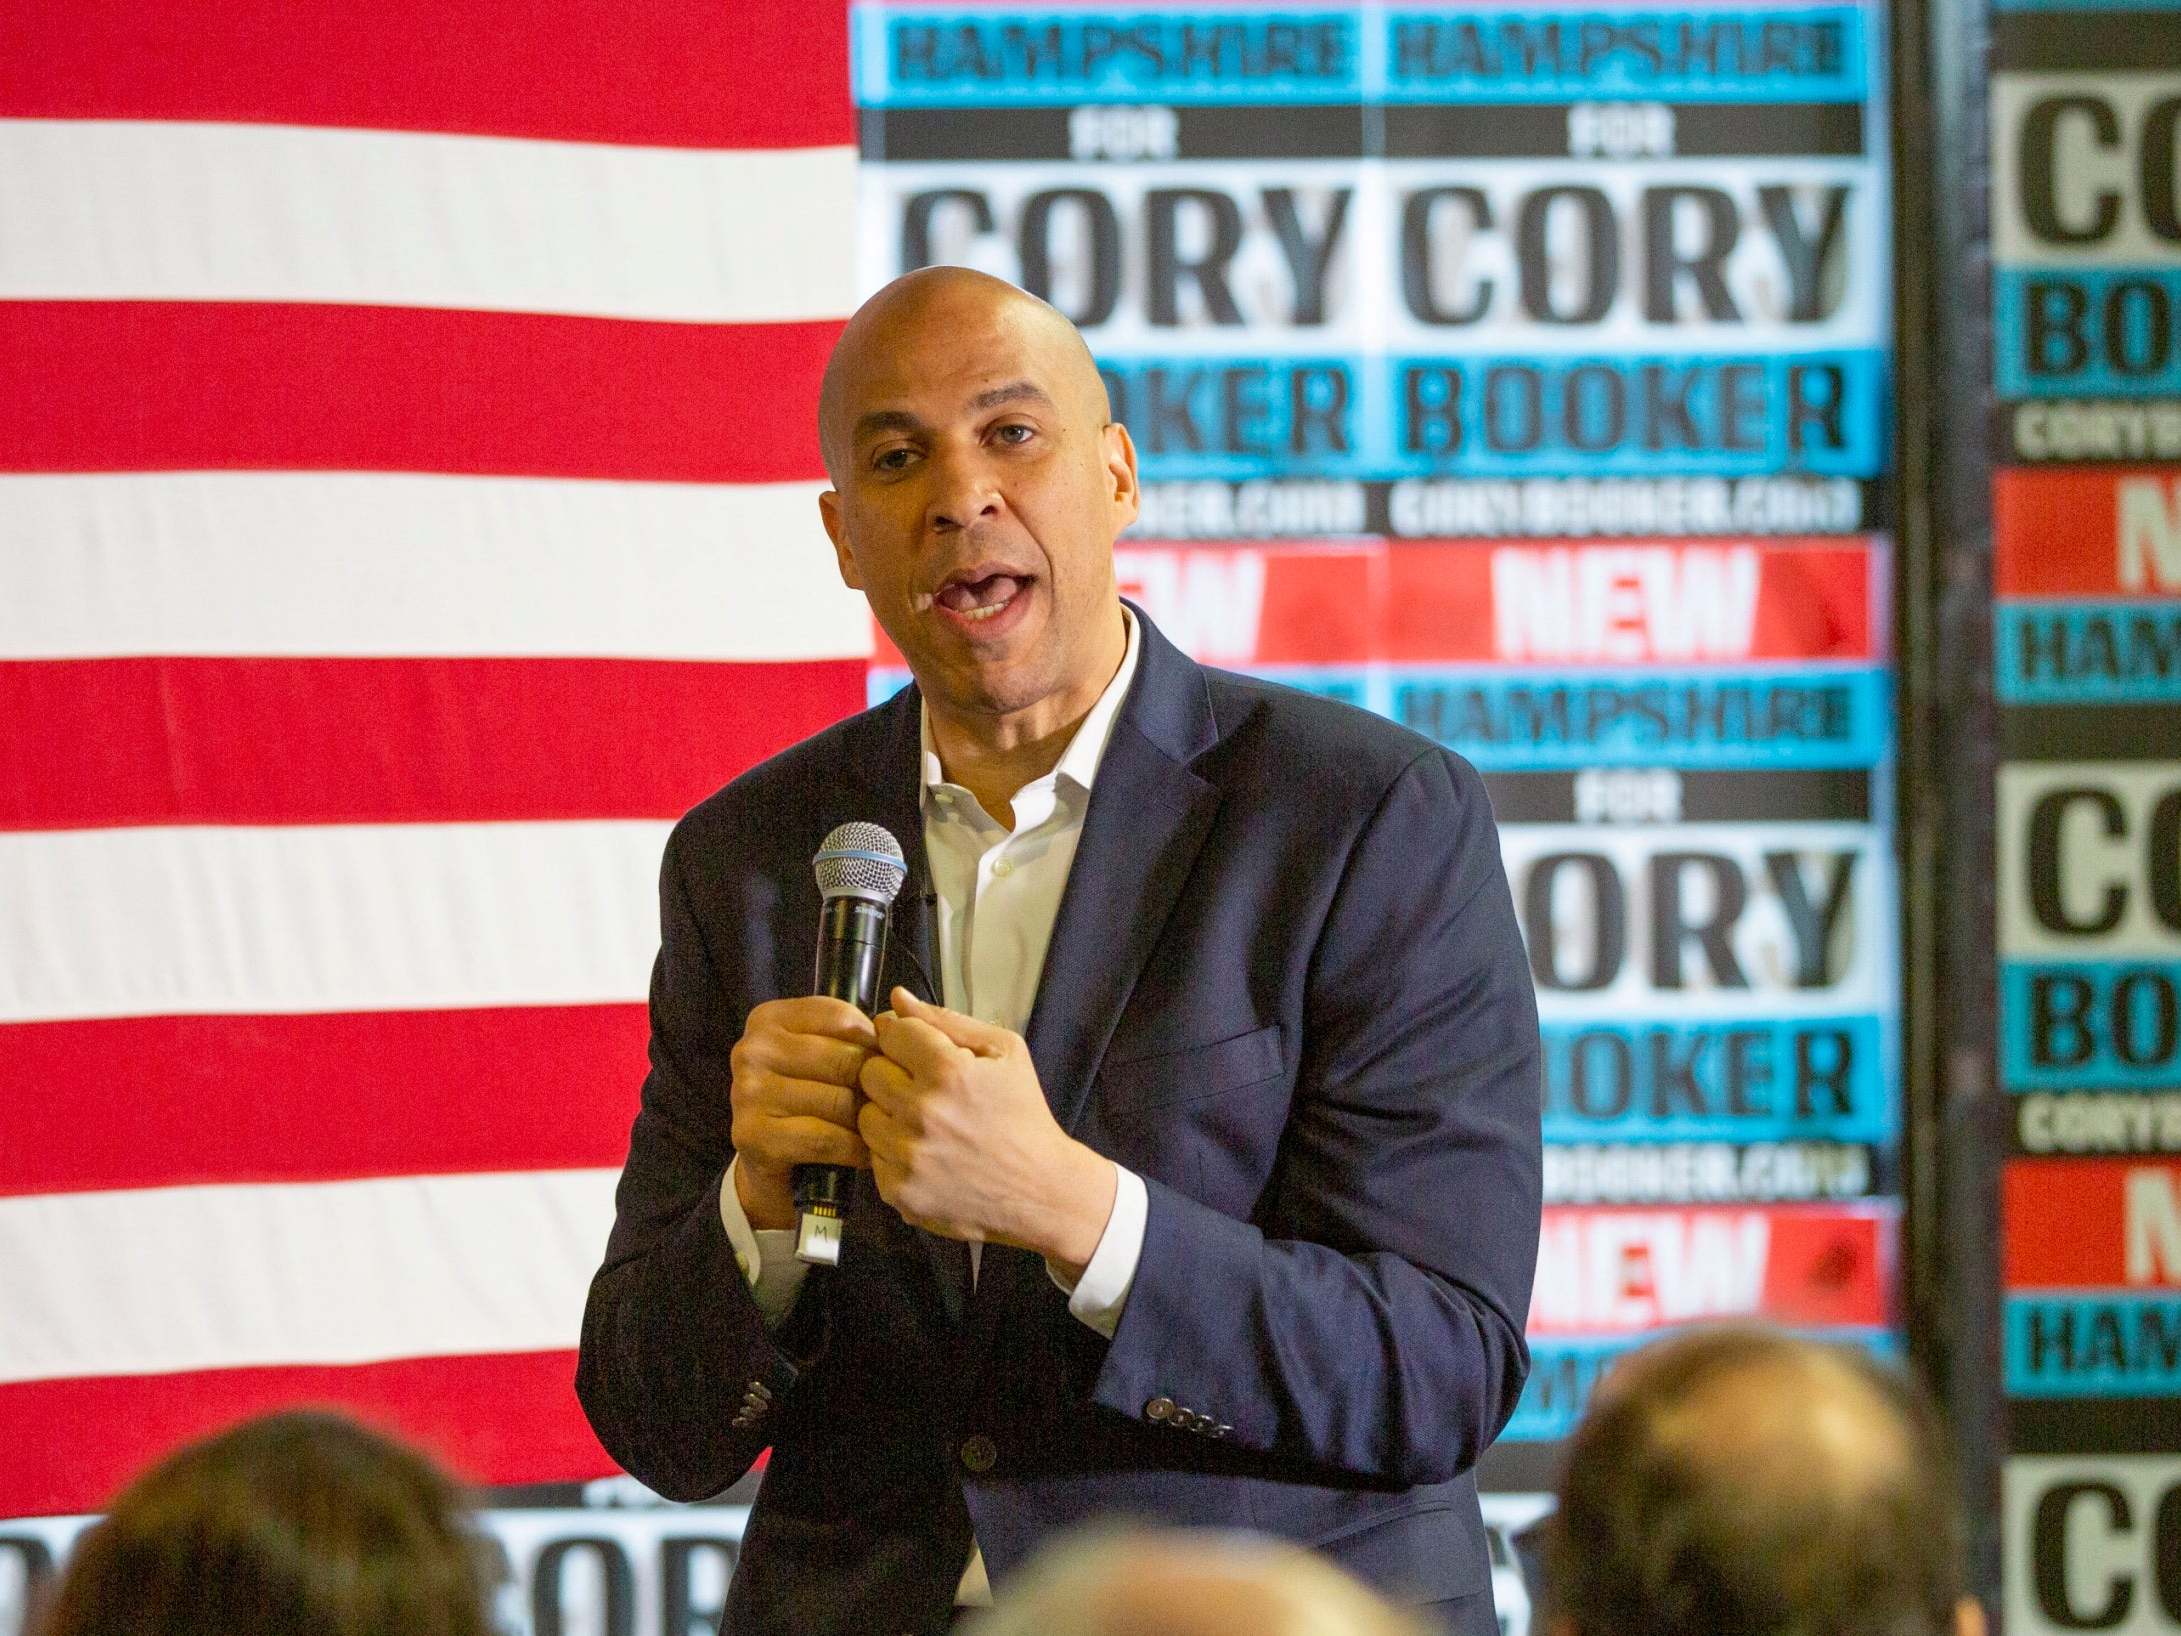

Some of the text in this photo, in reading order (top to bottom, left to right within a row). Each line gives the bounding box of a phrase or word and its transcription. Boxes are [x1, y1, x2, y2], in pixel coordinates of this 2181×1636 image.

[898, 21, 1345, 80] HAMPSHIRE
[1397, 20, 1845, 77] HAMPSHIRE
[902, 186, 1352, 328] CORY
[1402, 184, 1856, 326] CORY
[1405, 364, 1848, 454] BOOKER
[1490, 545, 1760, 661] NEW
[1403, 687, 1852, 742] HAMPSHIRE
[1524, 852, 1861, 991] ORY
[2031, 973, 2178, 1067] BO
[1542, 1029, 1856, 1119] OKER
[2034, 1483, 2181, 1629] C
